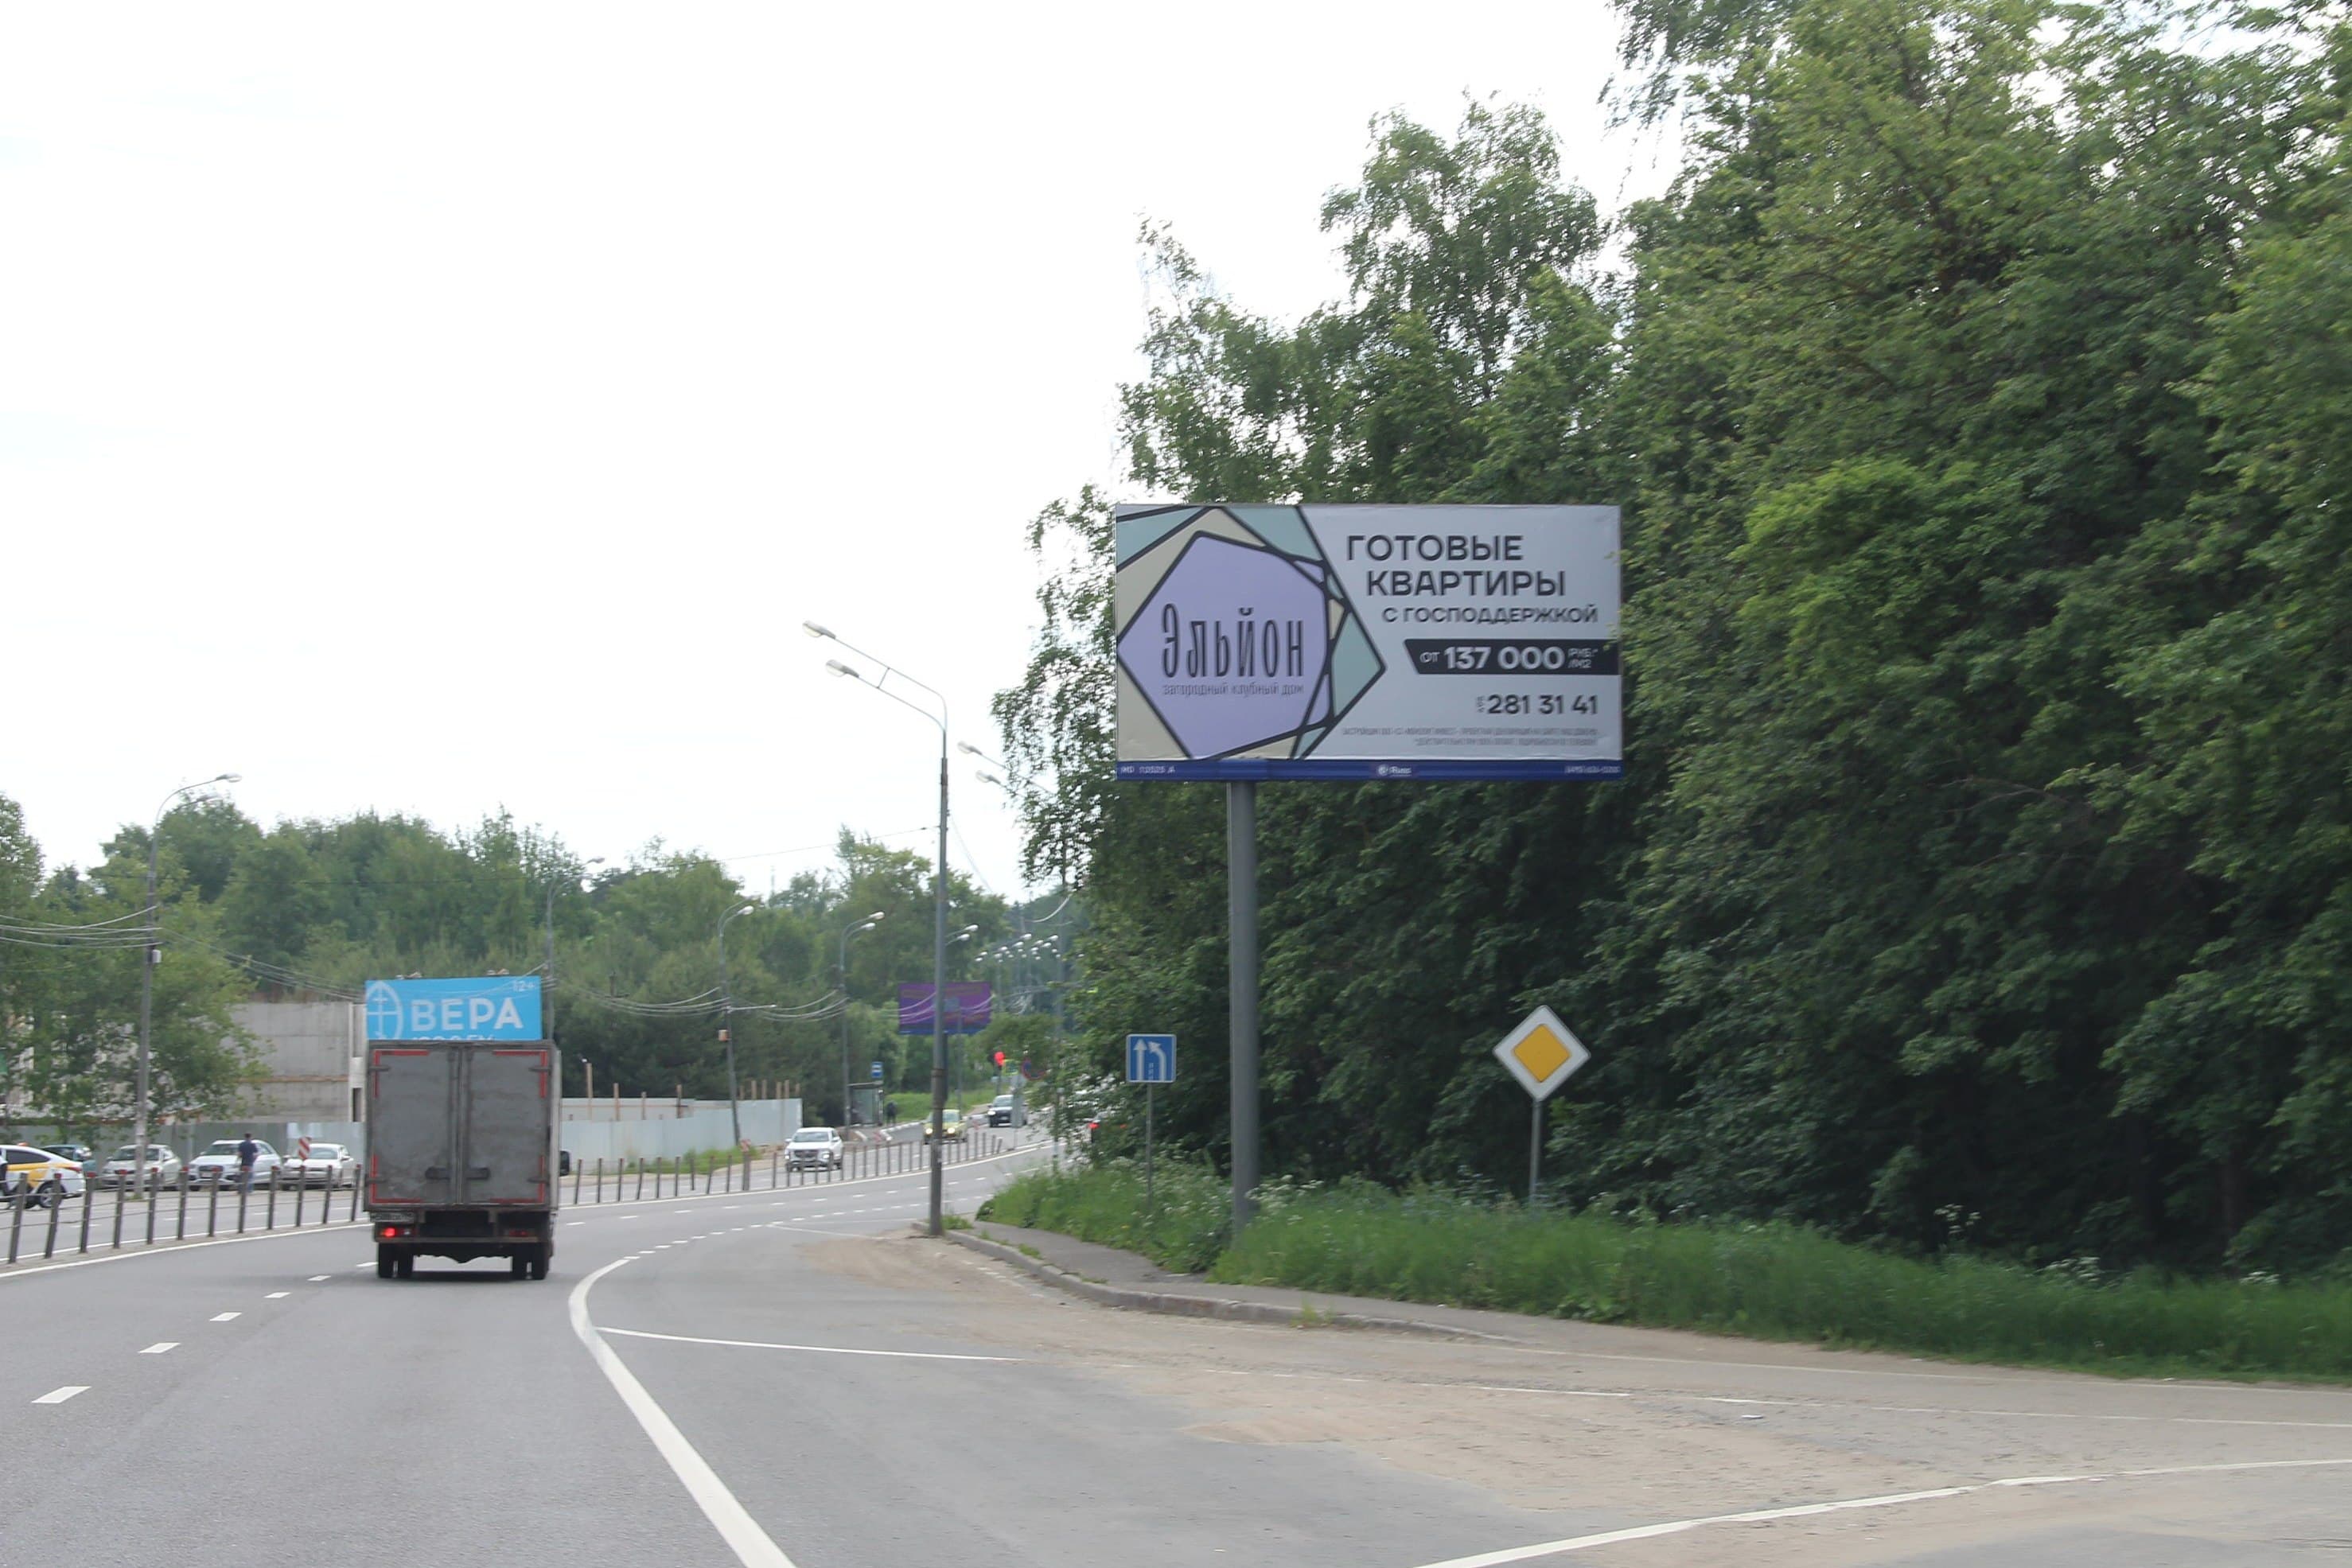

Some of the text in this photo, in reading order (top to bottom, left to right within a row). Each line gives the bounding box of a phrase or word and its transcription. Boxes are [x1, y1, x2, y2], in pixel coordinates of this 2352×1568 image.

[1346, 535, 1524, 561] ГОТОВЫЕ
[1366, 570, 1566, 596] КВАРТИРЫ
[1382, 604, 1599, 624] С ГОСПОДДЕРЖКОЙ
[1443, 646, 1491, 670] 137
[1497, 646, 1565, 670] 000
[1487, 694, 1530, 714] 281
[1539, 694, 1564, 714] 31
[1571, 694, 1599, 714] 41
[411, 997, 524, 1032] ВЕРА
